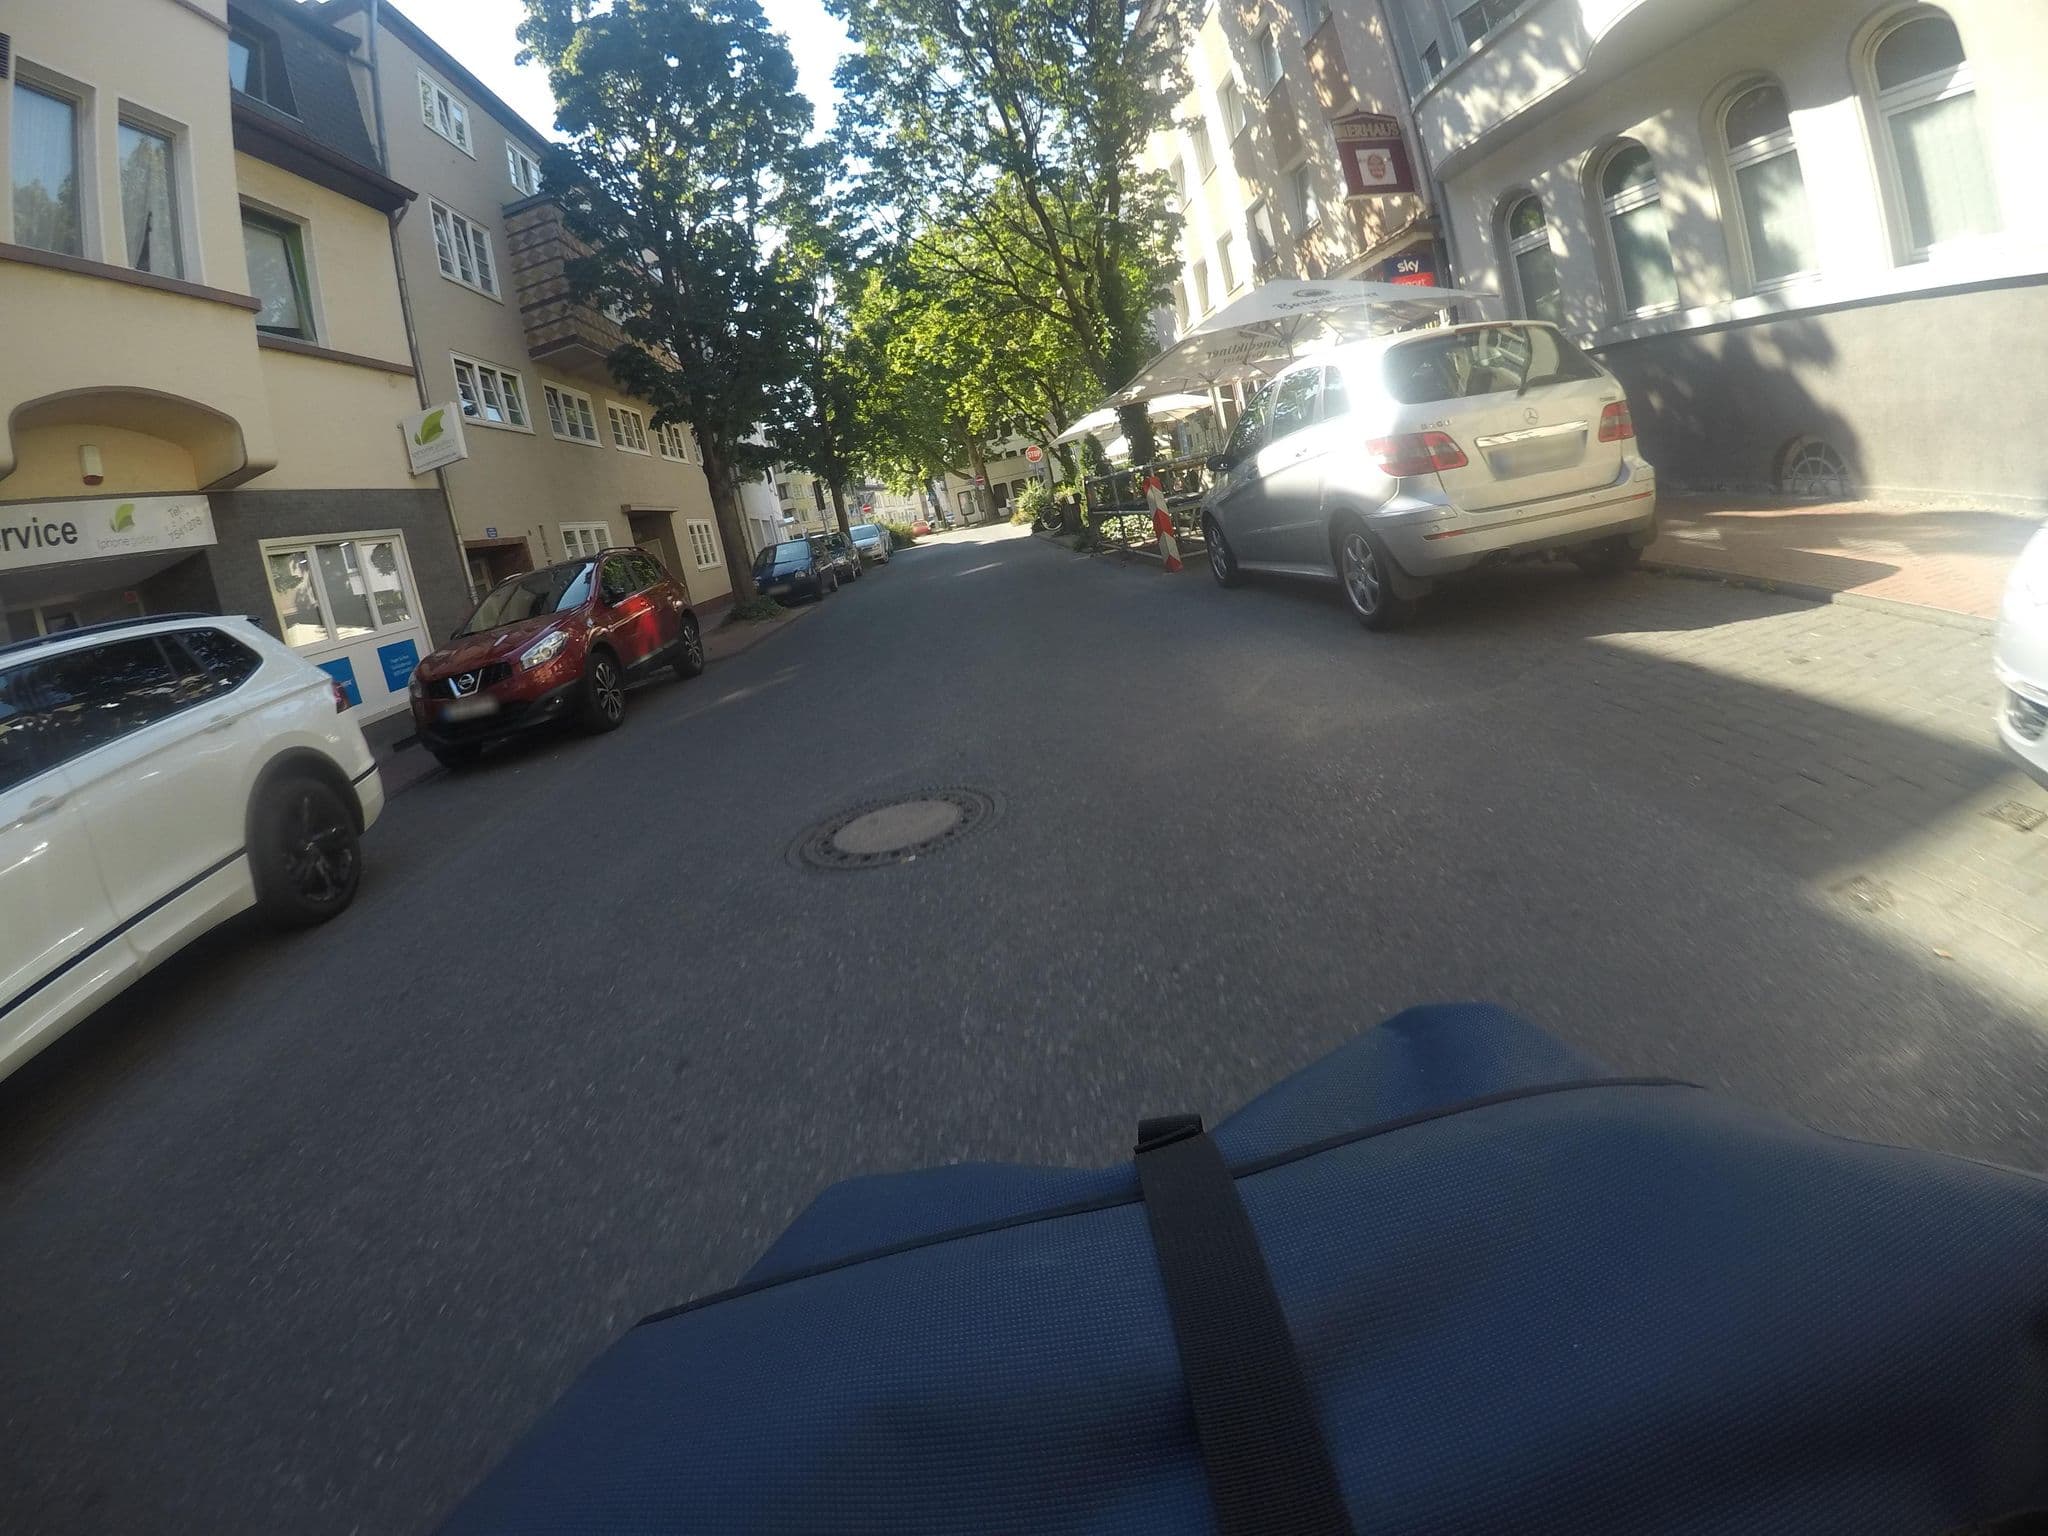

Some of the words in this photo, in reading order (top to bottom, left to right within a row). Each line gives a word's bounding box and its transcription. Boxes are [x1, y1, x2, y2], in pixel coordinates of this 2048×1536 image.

[1335, 122, 1400, 137] IERHAUS
[1397, 259, 1419, 273] sky
[1028, 450, 1040, 458] STOP
[0, 517, 79, 551] rvice
